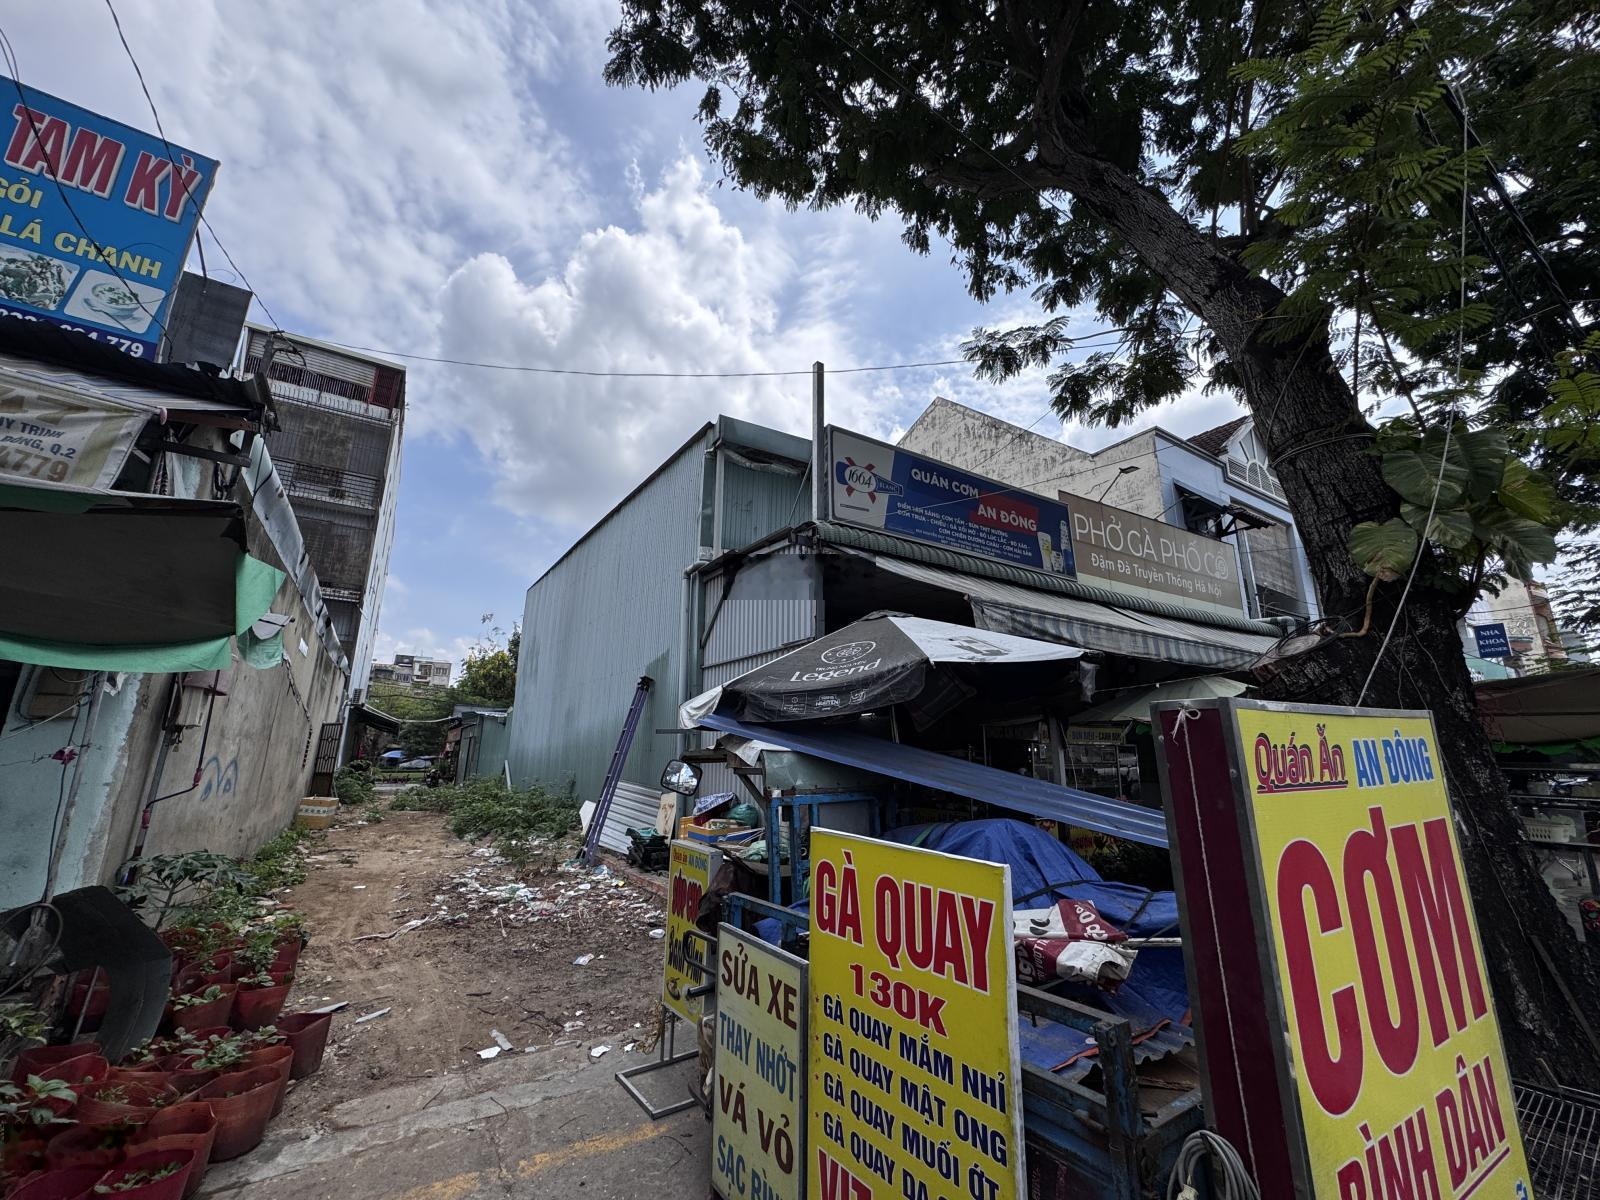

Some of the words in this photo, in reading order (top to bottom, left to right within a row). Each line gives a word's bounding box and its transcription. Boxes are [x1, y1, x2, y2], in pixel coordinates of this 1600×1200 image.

[4, 104, 126, 199] TAM
[124, 151, 202, 223] KỲ
[0, 214, 43, 244] LÁ
[54, 232, 162, 279] CHANH
[848, 469, 873, 488] 1664
[911, 468, 949, 490] QUÁN
[952, 481, 979, 499] CƠM
[977, 504, 997, 520] AN
[1000, 511, 1037, 531] ĐÔNG
[1073, 512, 1124, 552] PHỞ
[1127, 527, 1159, 562] GÀ
[1160, 538, 1200, 572] PHỐ
[1091, 552, 1115, 572] Đậm
[1117, 559, 1131, 575] Đà
[1133, 564, 1164, 586] Truyền
[1166, 572, 1193, 593] Thống
[1195, 579, 1206, 593] Hà
[1208, 582, 1222, 599] Nội
[790, 658, 881, 681] Legend
[1254, 731, 1314, 792] Quán
[1316, 723, 1346, 783] Ăn
[1352, 739, 1384, 787] AN
[1381, 729, 1434, 784] ĐÔNG
[815, 848, 864, 947] GÀ
[875, 874, 996, 996] QUAY
[721, 942, 760, 1006] SỬA
[768, 973, 797, 1030] XE
[1276, 805, 1489, 1116] CƠM
[849, 962, 948, 1038] 130K
[719, 1010, 752, 1066] THAY
[756, 1037, 796, 1102] NHỚT
[823, 994, 844, 1025] GÀ
[849, 1007, 893, 1050] QUAY
[899, 1031, 954, 1085] MẮM
[961, 1063, 1006, 1114] NHỈ
[718, 1073, 747, 1135] VÁ
[757, 1107, 793, 1174] VỎ
[823, 1032, 844, 1065] GÀ
[850, 1047, 893, 1094] QUAY
[900, 1076, 946, 1127] MẬT
[954, 1109, 1007, 1168] ONG
[823, 1072, 845, 1107] GÀ
[850, 1089, 895, 1140] QUAY
[1435, 1053, 1506, 1192] DÂN
[717, 1134, 746, 1198] SẠC
[823, 1111, 845, 1148] GÀ
[850, 1131, 896, 1186] QUAY
